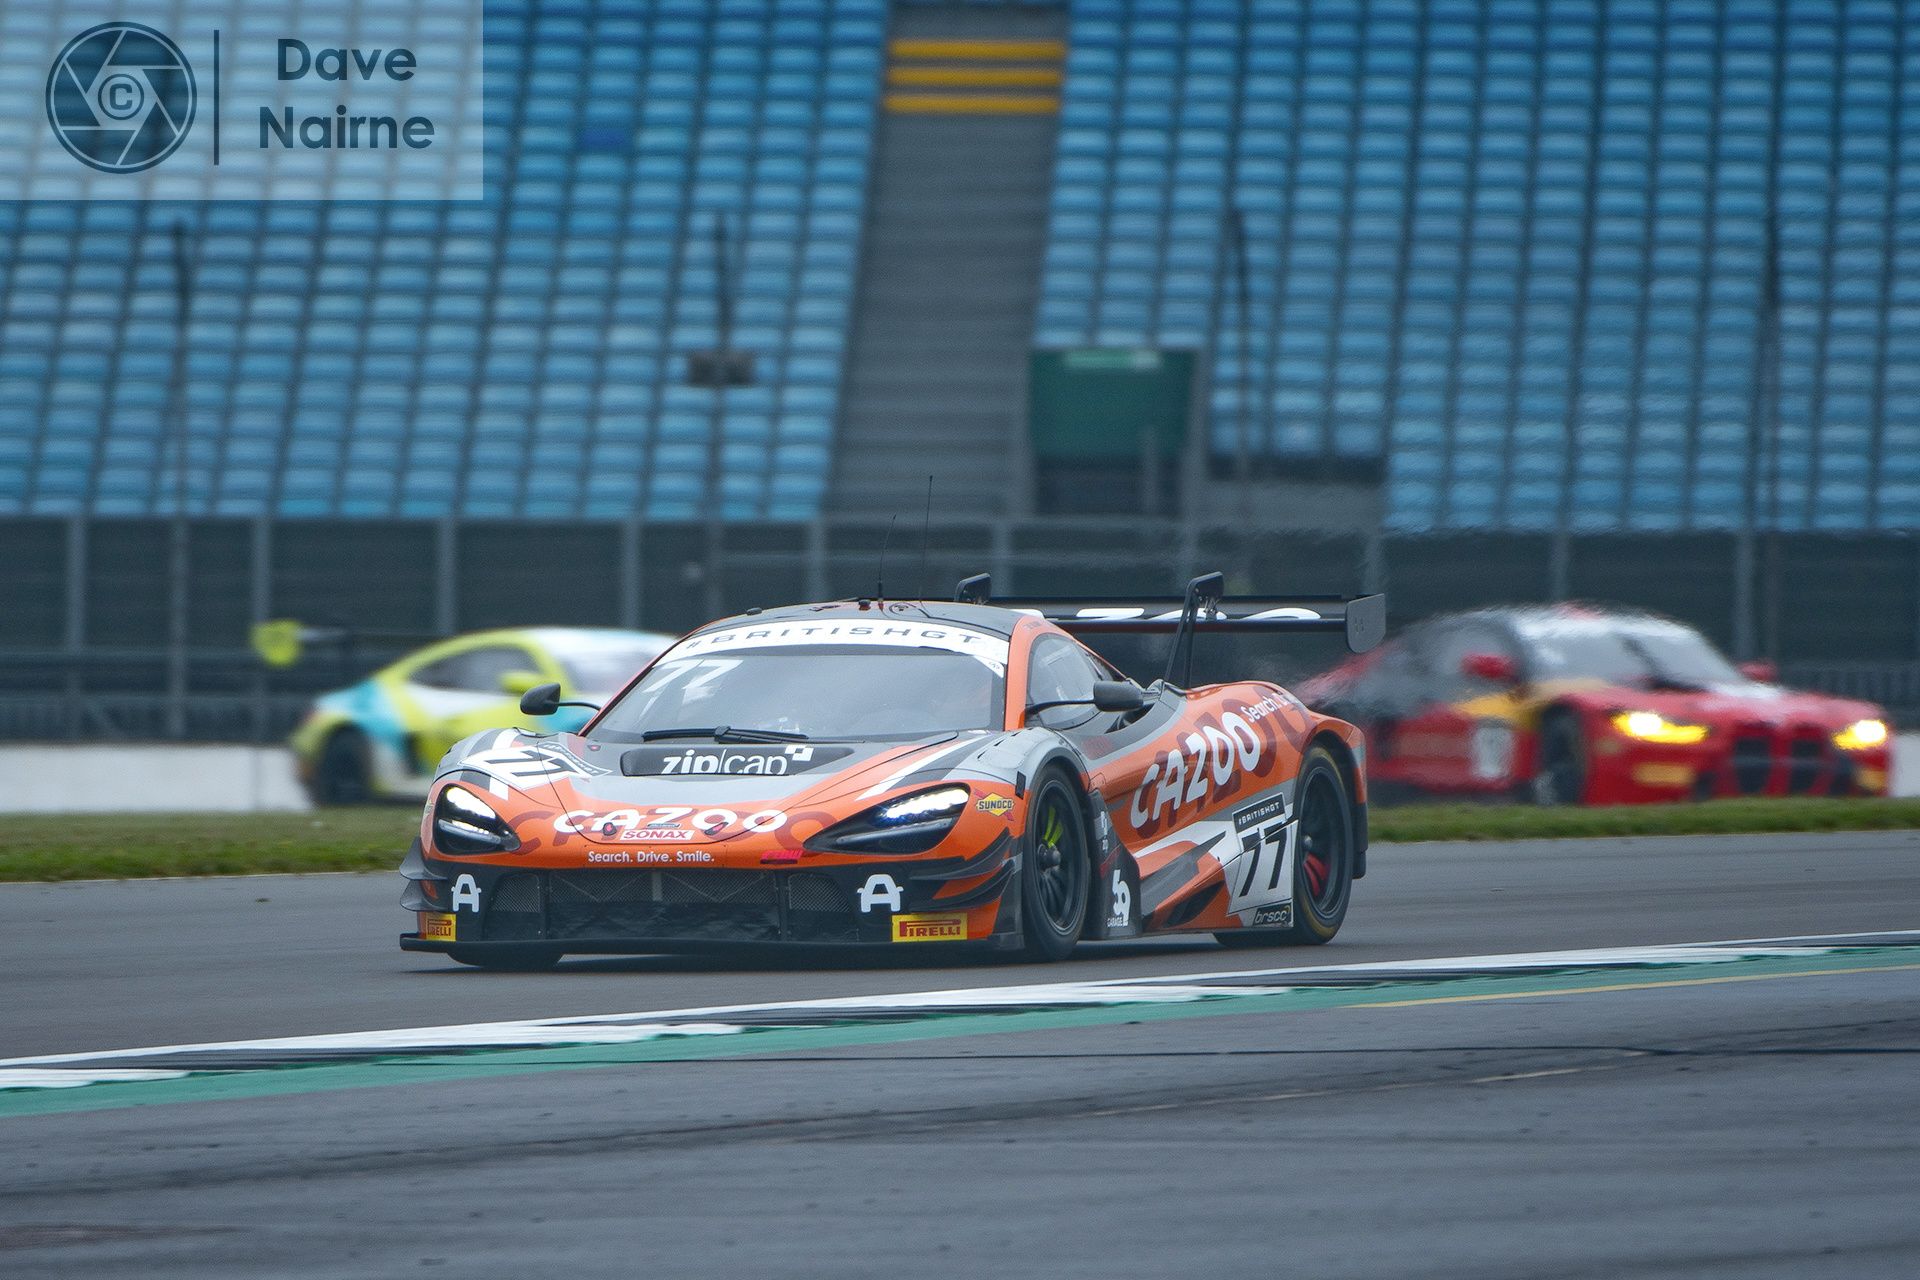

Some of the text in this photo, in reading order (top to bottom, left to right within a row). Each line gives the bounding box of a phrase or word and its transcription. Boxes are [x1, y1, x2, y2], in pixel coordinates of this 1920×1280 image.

[1130, 711, 1261, 829] CAZOO
[978, 800, 1012, 810] SUNOCO
[553, 807, 788, 834] CAZOO
[623, 830, 690, 840] SONAX
[588, 850, 715, 863] Search. Drive. Smile.
[1238, 821, 1288, 898] 77
[899, 918, 962, 938] PIRELLI
